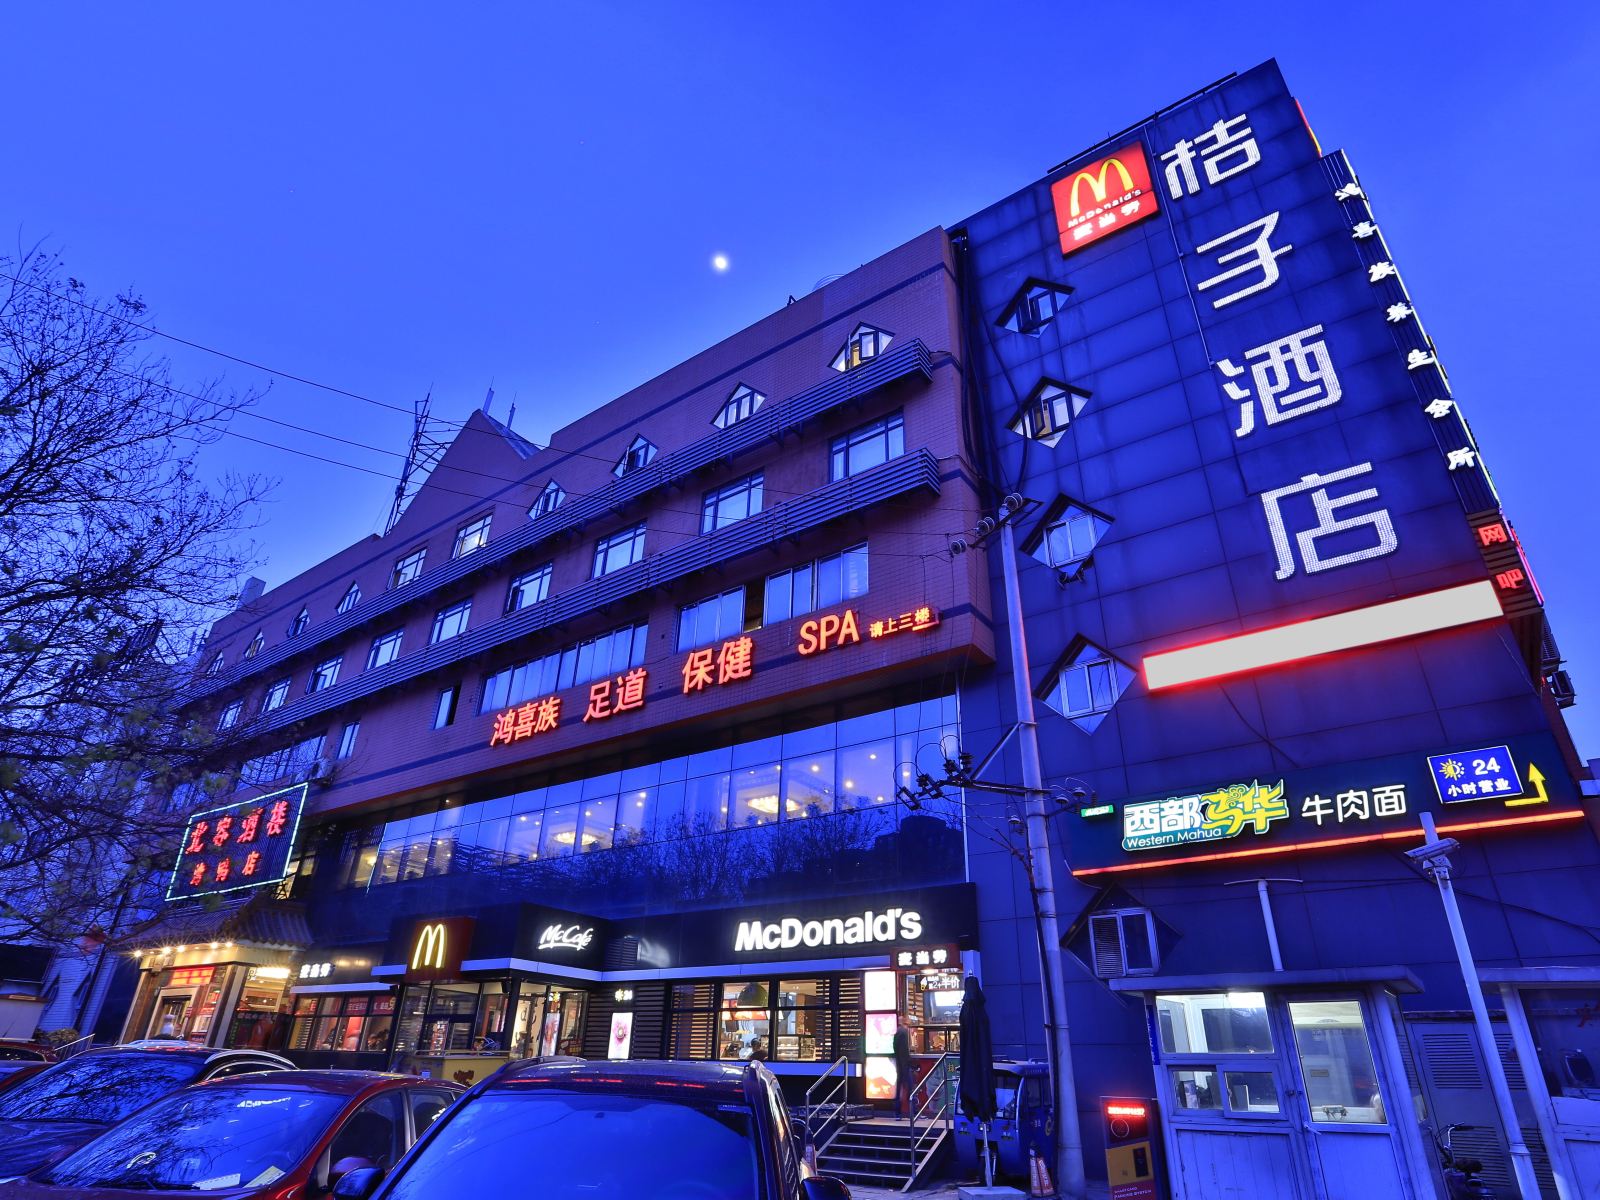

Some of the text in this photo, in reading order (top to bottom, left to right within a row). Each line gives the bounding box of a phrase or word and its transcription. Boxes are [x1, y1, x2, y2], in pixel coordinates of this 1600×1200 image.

[1067, 189, 1142, 228] McDonald's
[1161, 114, 1398, 580] 桔子酒店
[1478, 523, 1524, 589] 网吧
[490, 607, 930, 746] 鸿喜族 足道 保健 SPA 请上三楼
[1472, 757, 1501, 776] 24
[1301, 785, 1407, 826] 牛肉面
[1447, 778, 1511, 798] 小时营业
[1126, 828, 1222, 848] Western Mahua
[735, 908, 922, 952] McDonald's
